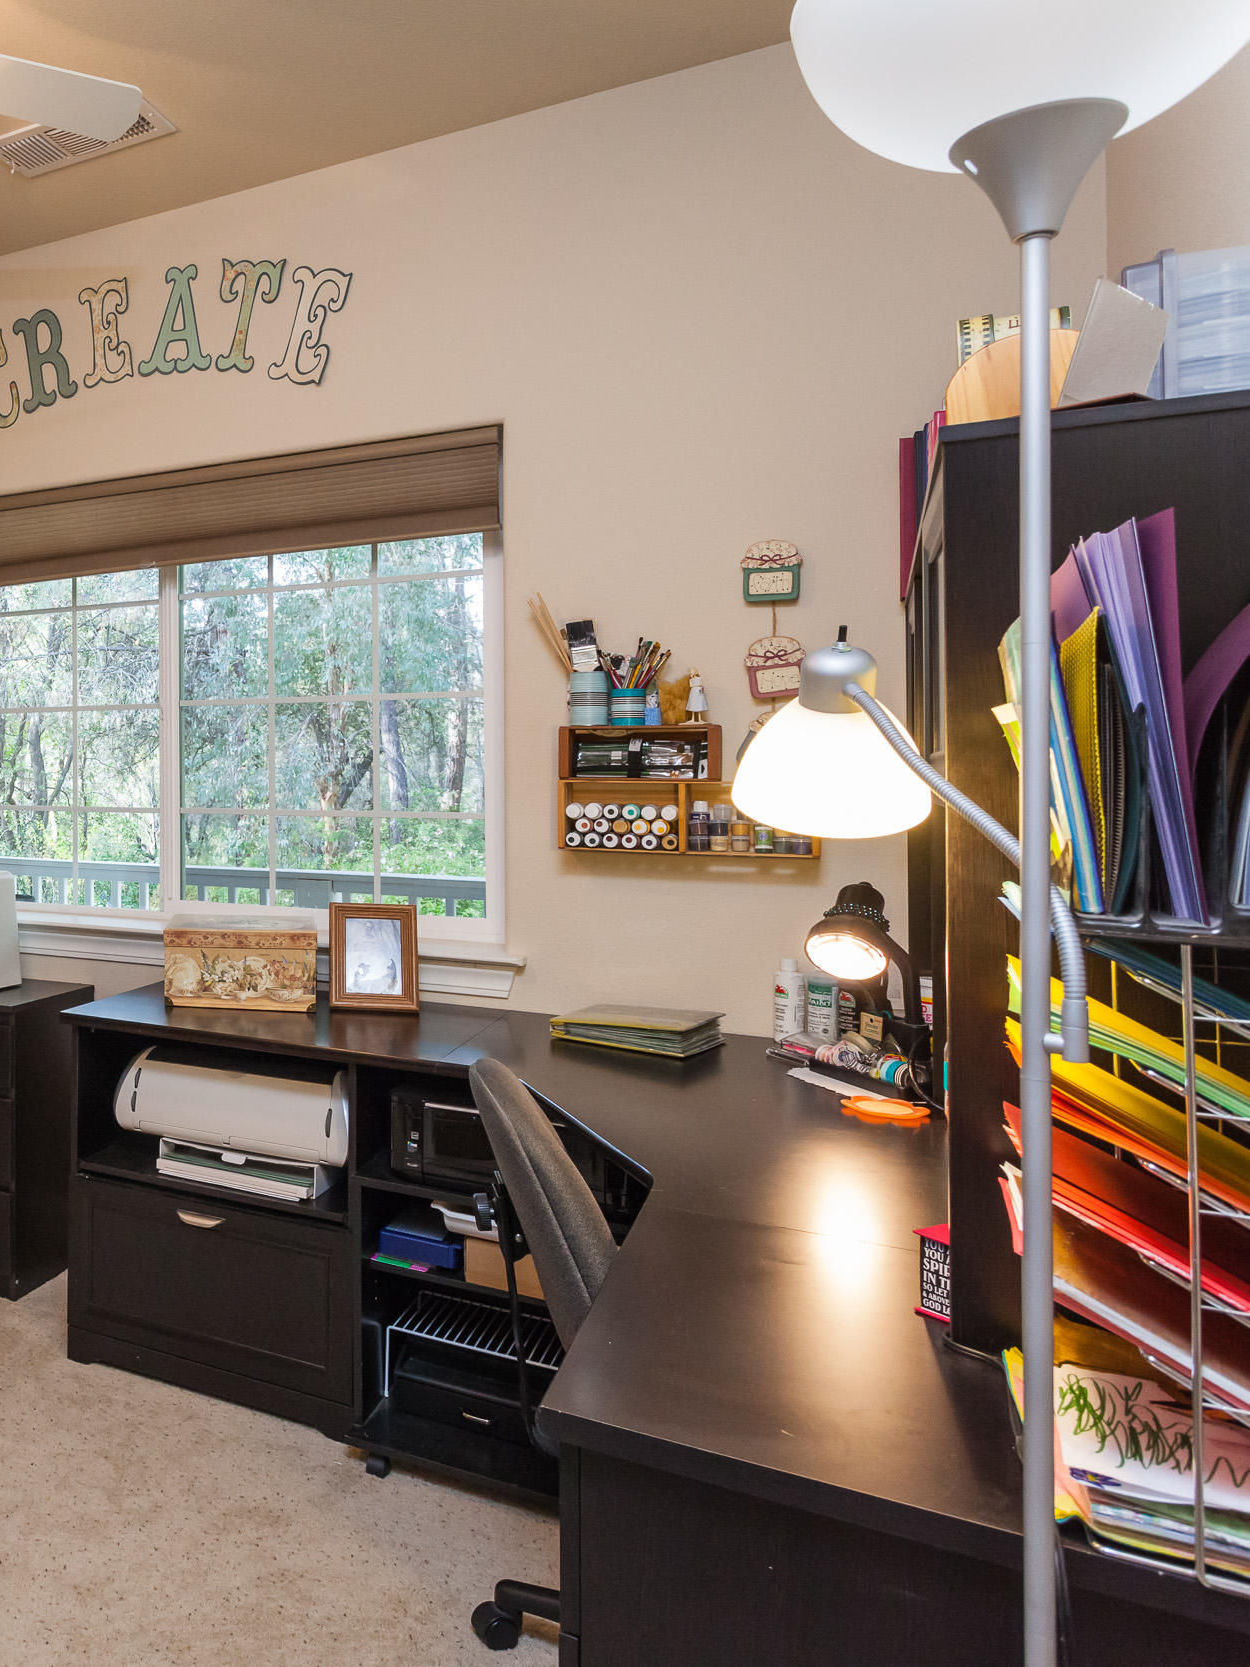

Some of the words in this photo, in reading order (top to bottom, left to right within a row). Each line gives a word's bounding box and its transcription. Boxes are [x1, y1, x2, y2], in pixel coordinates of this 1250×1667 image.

[924, 1247, 944, 1262] YOU
[923, 1270, 936, 1285] IN
[922, 1282, 933, 1292] SO
[934, 1286, 948, 1298] LET
[922, 1298, 942, 1311] GOD
